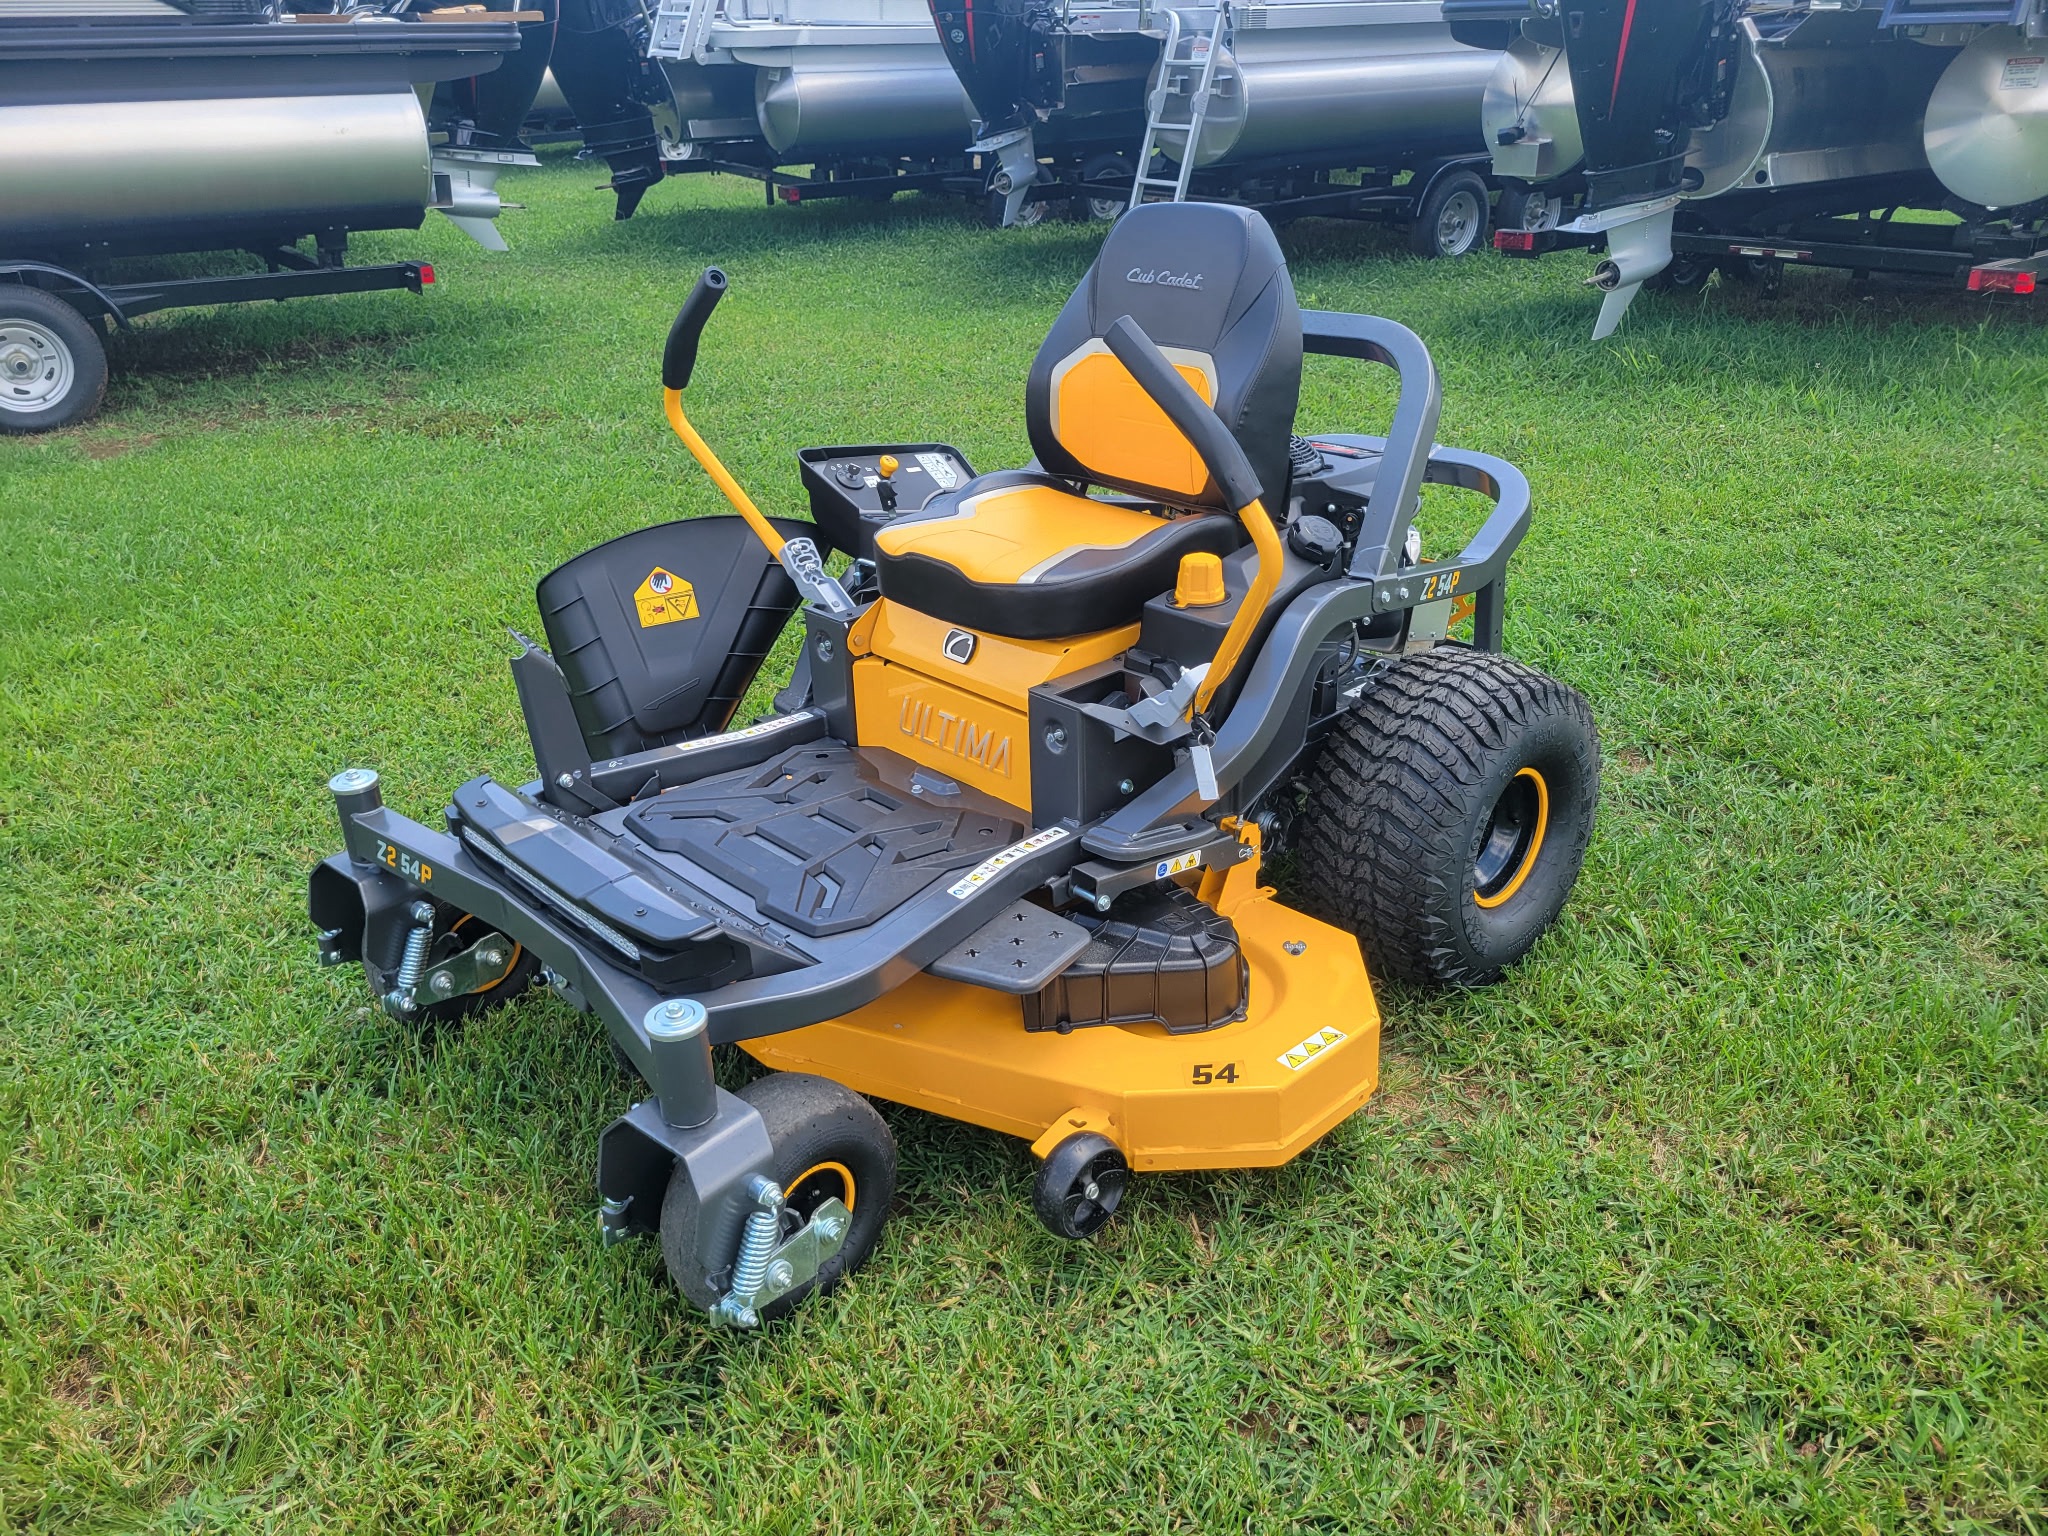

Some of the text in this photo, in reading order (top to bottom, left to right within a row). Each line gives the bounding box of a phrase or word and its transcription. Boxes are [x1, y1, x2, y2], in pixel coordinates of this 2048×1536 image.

[1126, 267, 1203, 290] Cub Cadet
[1420, 570, 1461, 601] Z2 54P
[900, 695, 1013, 779] ULTIMA
[377, 839, 432, 884] Z2 54P
[1192, 1062, 1240, 1085] 54
